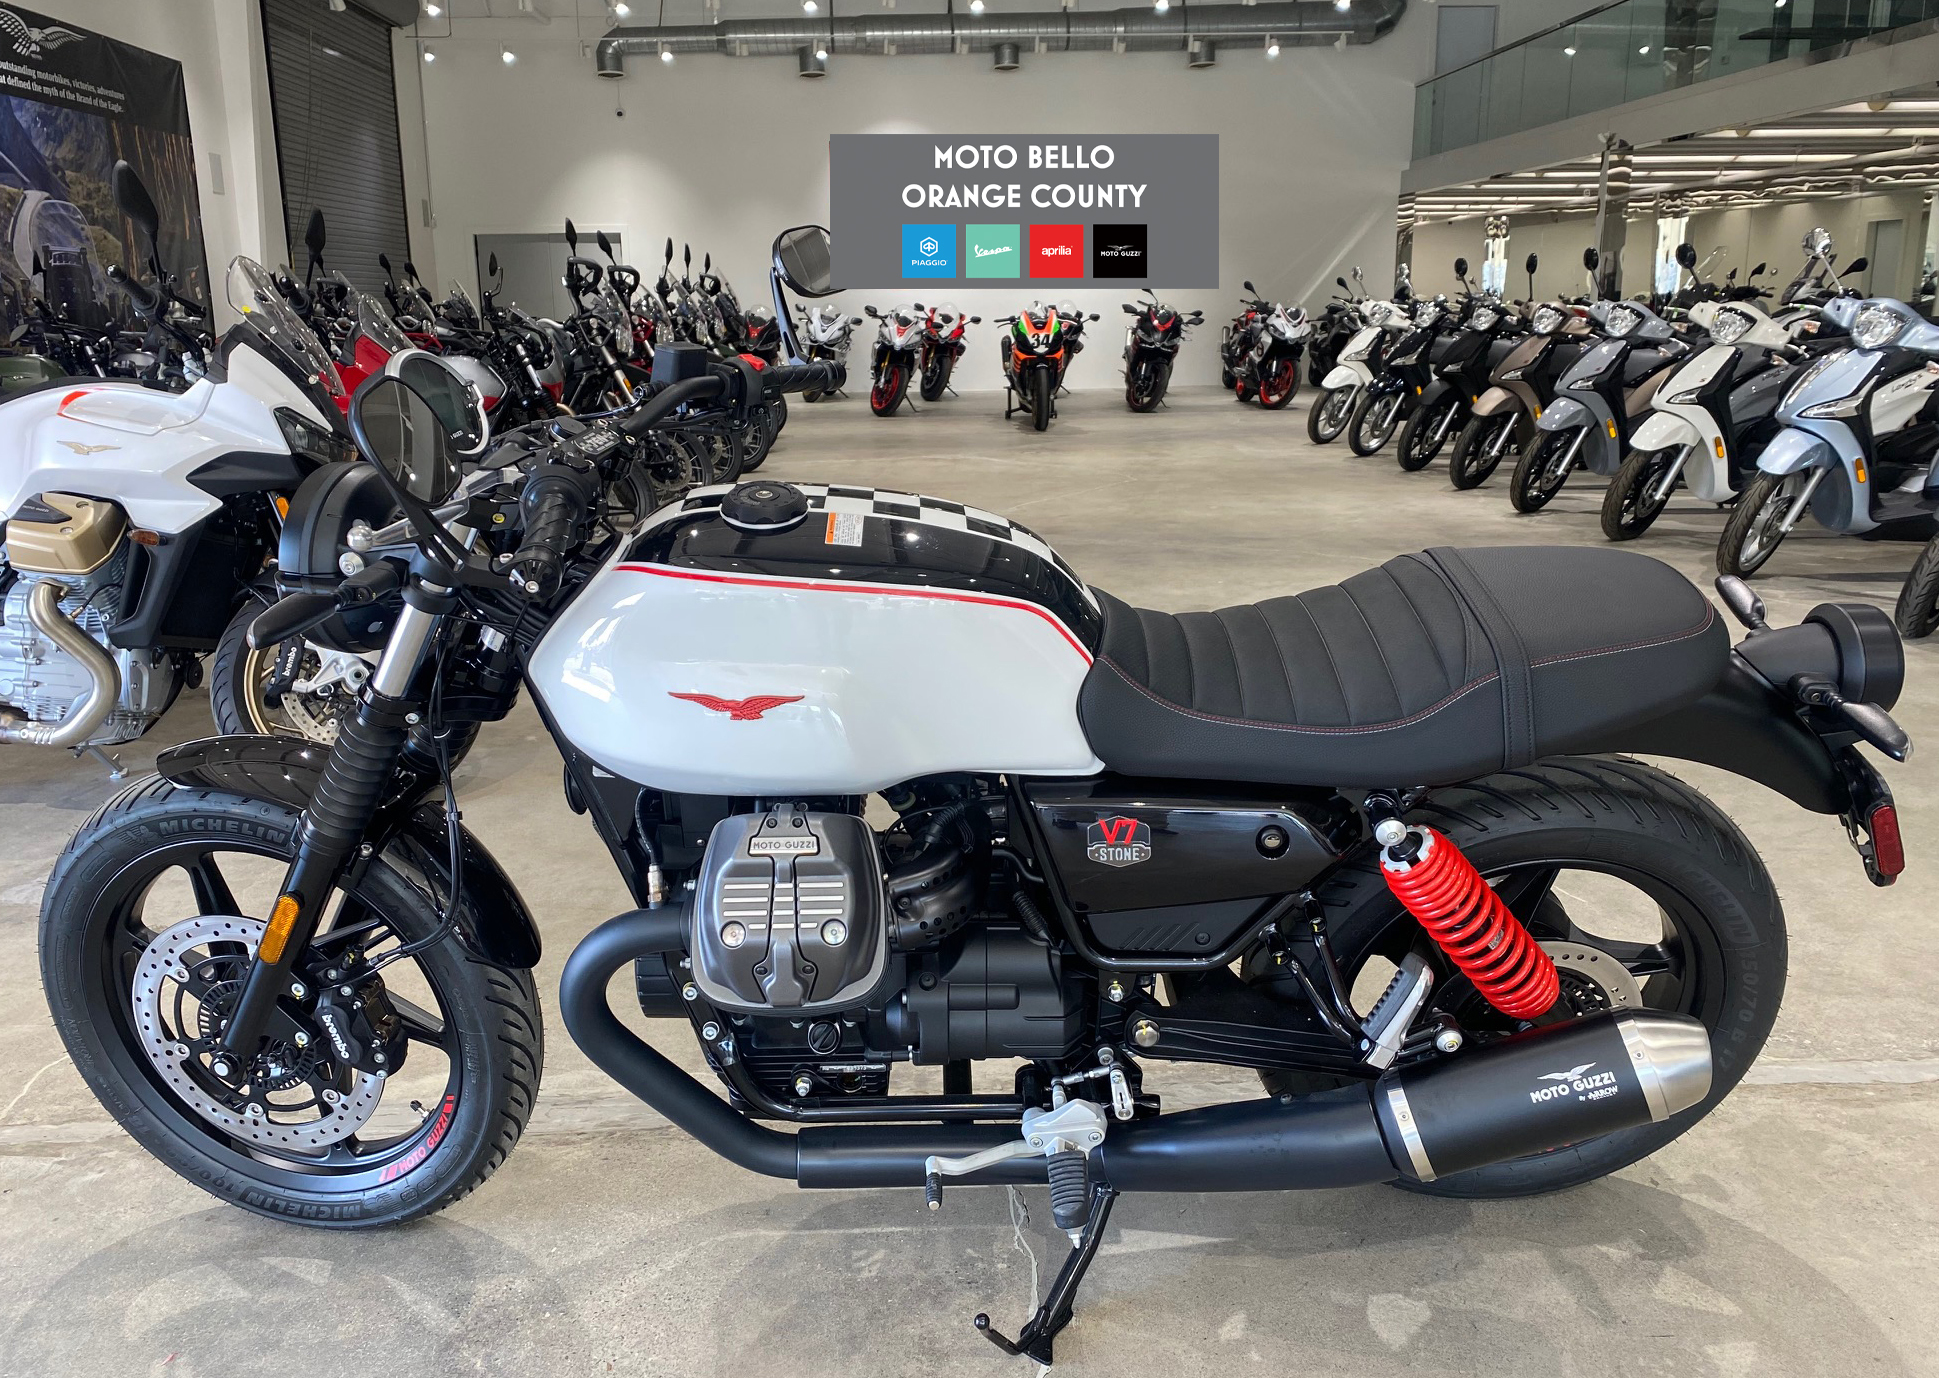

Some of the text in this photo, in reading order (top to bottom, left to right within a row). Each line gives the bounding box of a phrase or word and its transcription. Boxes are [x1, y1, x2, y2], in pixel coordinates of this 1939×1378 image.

[7, 76, 31, 90] defined
[32, 81, 42, 93] the
[43, 86, 59, 98] myth
[59, 88, 66, 99] of
[66, 90, 76, 101] the
[1031, 333, 1051, 348] 34
[281, 646, 298, 677] brembo
[159, 818, 286, 844] MICHELIN
[1099, 818, 1138, 844] V7
[753, 840, 815, 849] MOTO GUZZI
[1100, 847, 1140, 861] STONE
[321, 1014, 350, 1059] brembo
[1530, 1071, 1617, 1104] MOTO GUZZI
[398, 1146, 427, 1174] MOTO
[426, 1112, 449, 1150] GUZZI
[245, 1191, 361, 1219] MICHELIN
